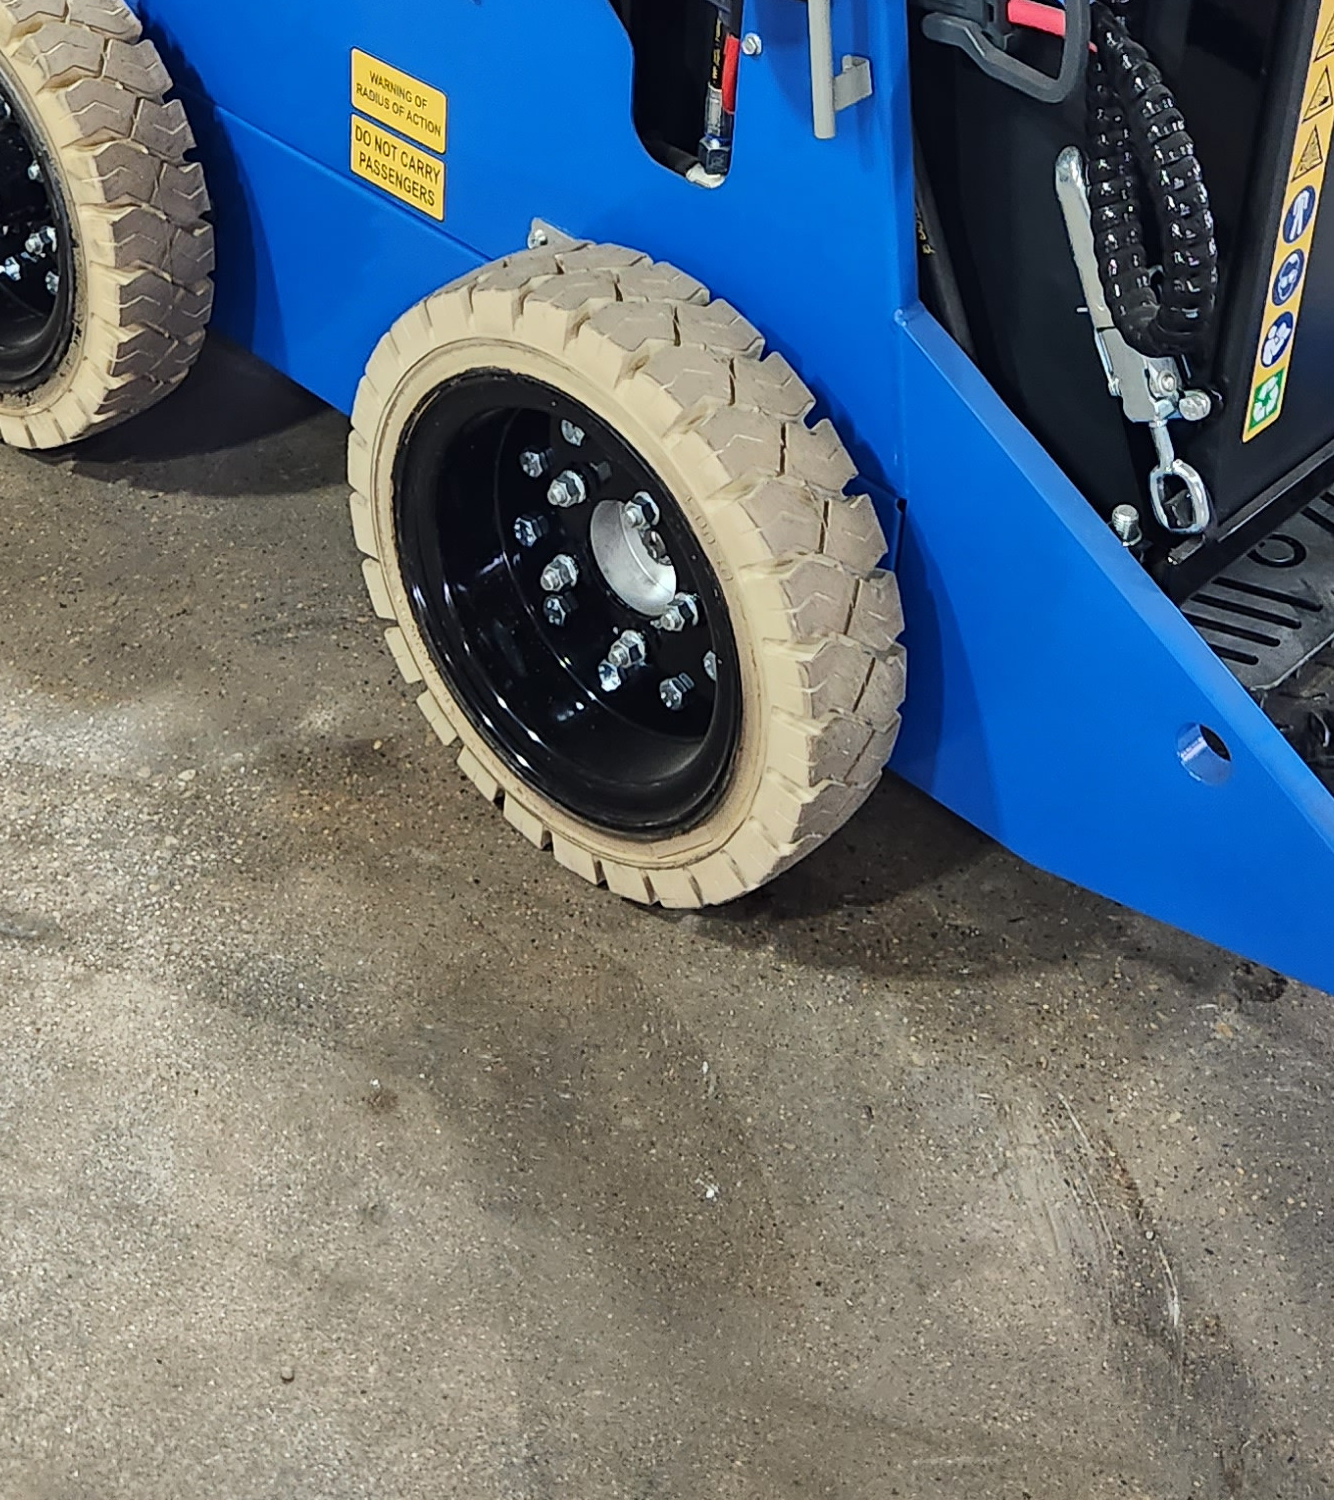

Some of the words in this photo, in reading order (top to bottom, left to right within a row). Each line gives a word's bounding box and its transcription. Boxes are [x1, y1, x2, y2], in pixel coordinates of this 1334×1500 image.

[356, 82, 390, 110] RADIUS
[392, 101, 405, 117] OF
[406, 110, 441, 137] ACTION
[369, 70, 412, 103] WARNING
[415, 95, 428, 110] OF
[355, 125, 372, 147] DO
[374, 136, 398, 162] NOT
[400, 151, 441, 185] CARRY
[359, 151, 435, 207] PASSENGERS
